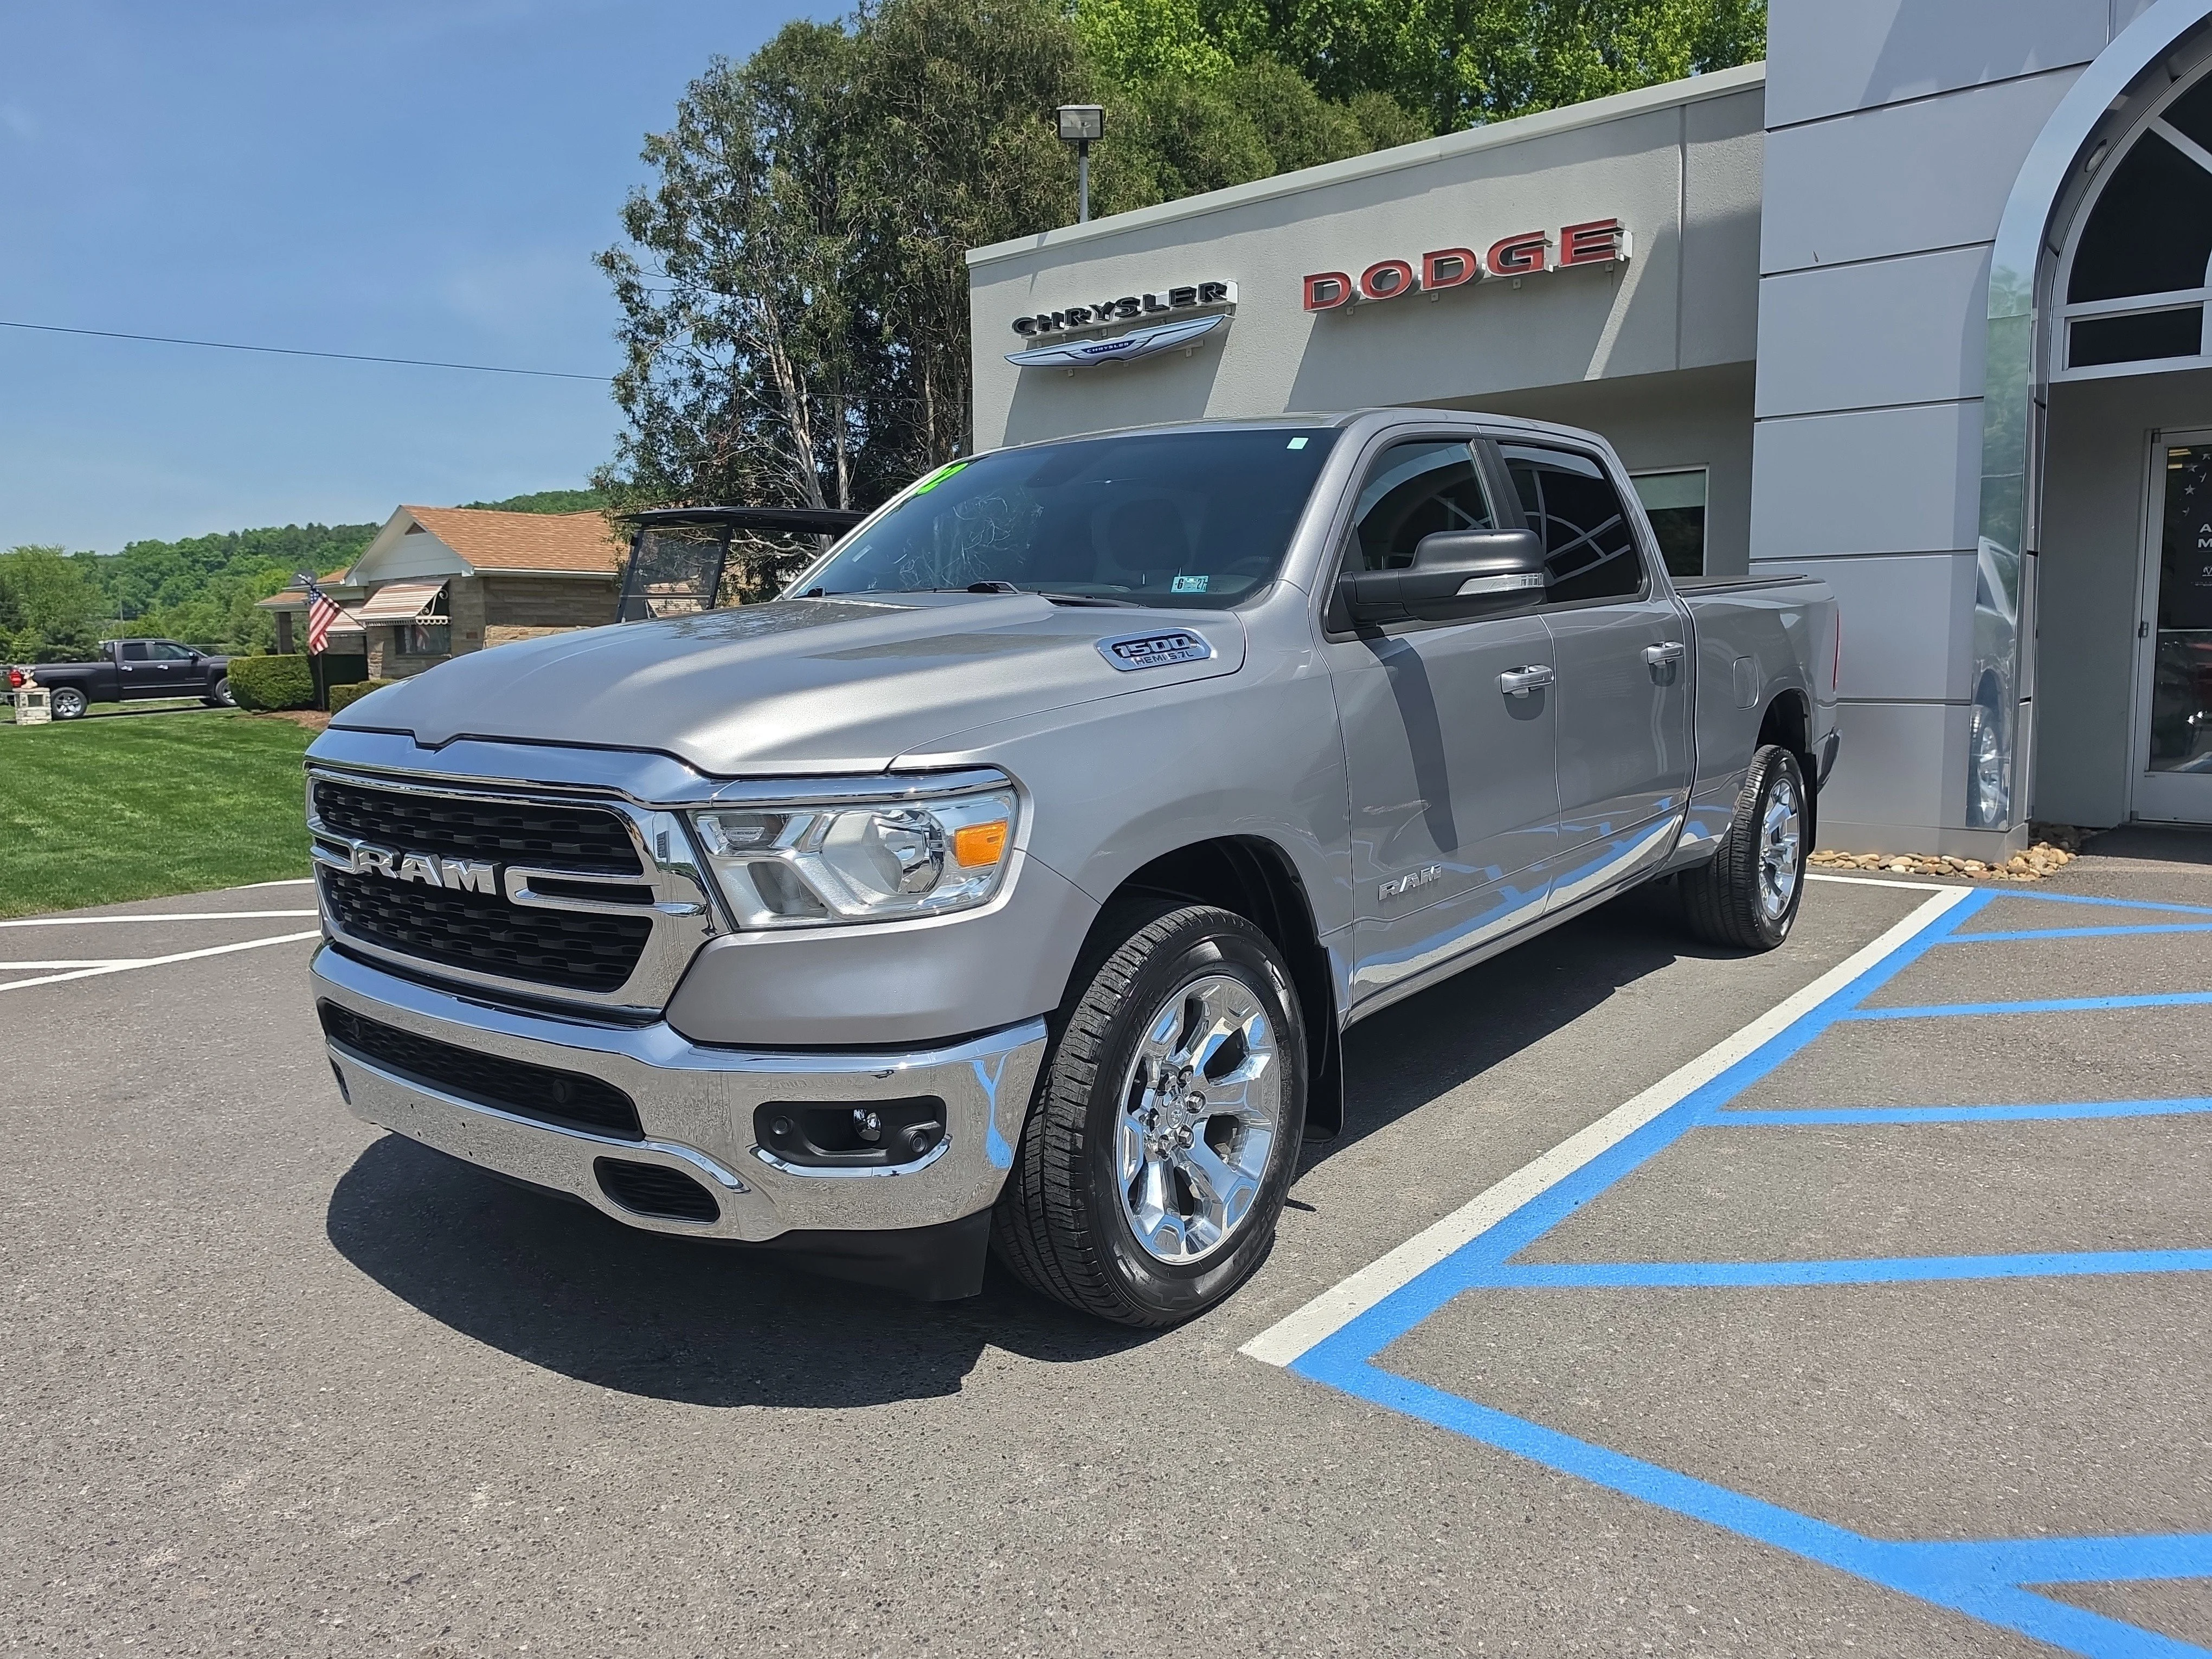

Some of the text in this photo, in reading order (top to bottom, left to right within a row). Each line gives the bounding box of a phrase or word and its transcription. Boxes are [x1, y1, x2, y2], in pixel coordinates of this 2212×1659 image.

[1303, 218, 1622, 313] DODGE
[1012, 281, 1227, 335] CHRYSLER
[1086, 342, 1129, 353] CHRYSLER
[1176, 578, 1184, 590] 6
[1196, 578, 1206, 590] 27
[1116, 636, 1191, 658] 1500
[1134, 651, 1194, 666] HEMI 5.7L
[357, 842, 499, 896] RAM
[1378, 863, 1442, 901] RAM
